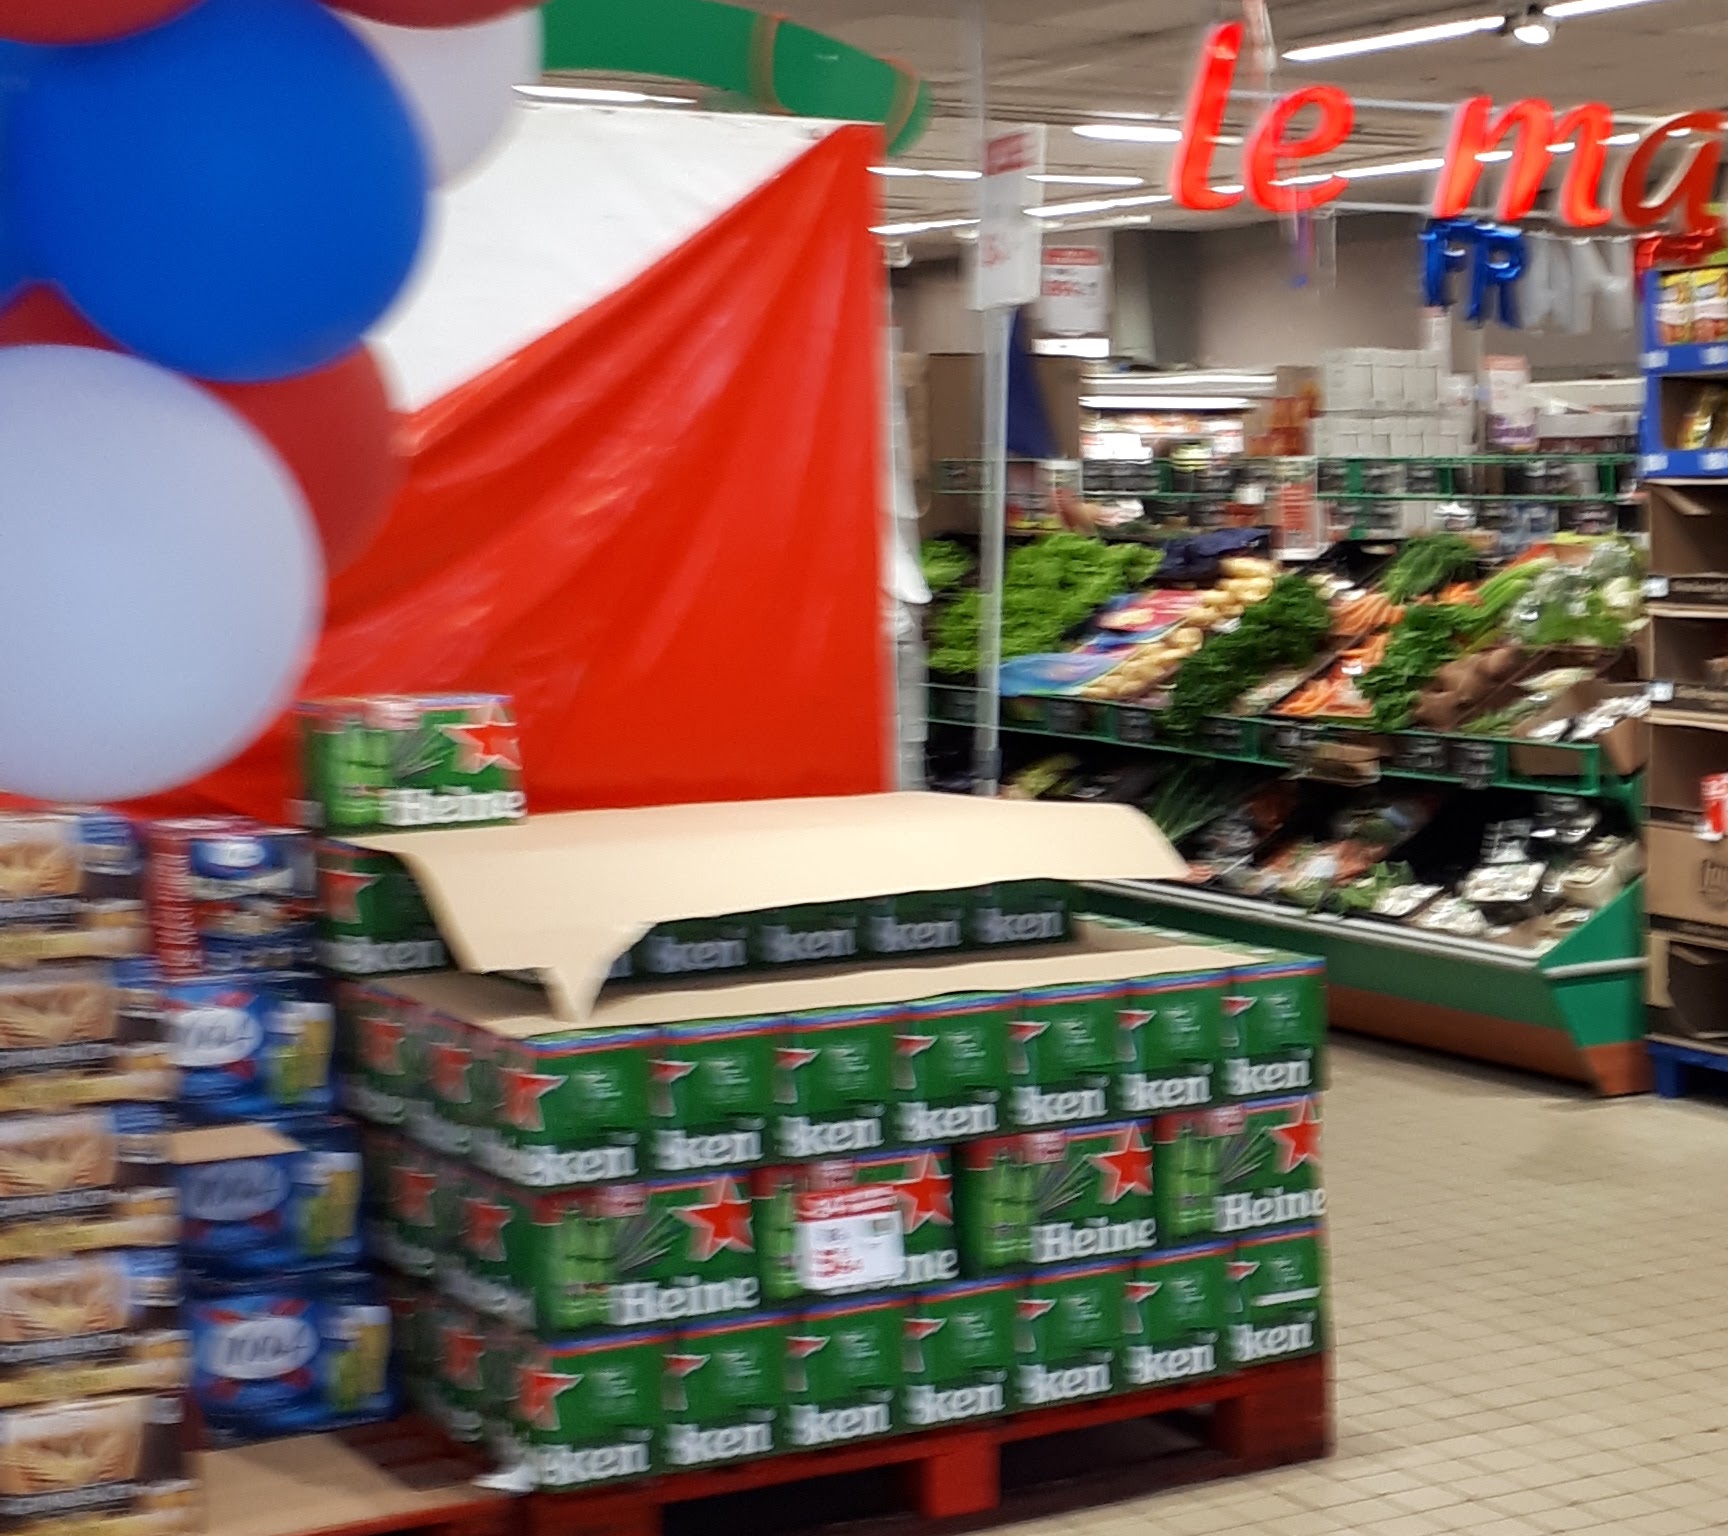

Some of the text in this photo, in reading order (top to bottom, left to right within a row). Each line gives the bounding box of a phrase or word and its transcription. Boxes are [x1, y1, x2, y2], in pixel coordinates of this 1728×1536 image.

[1168, 20, 1355, 214] le
[1213, 1185, 1328, 1233] Heine
[1030, 1216, 1158, 1264] Heine
[606, 1274, 761, 1327] Heine
